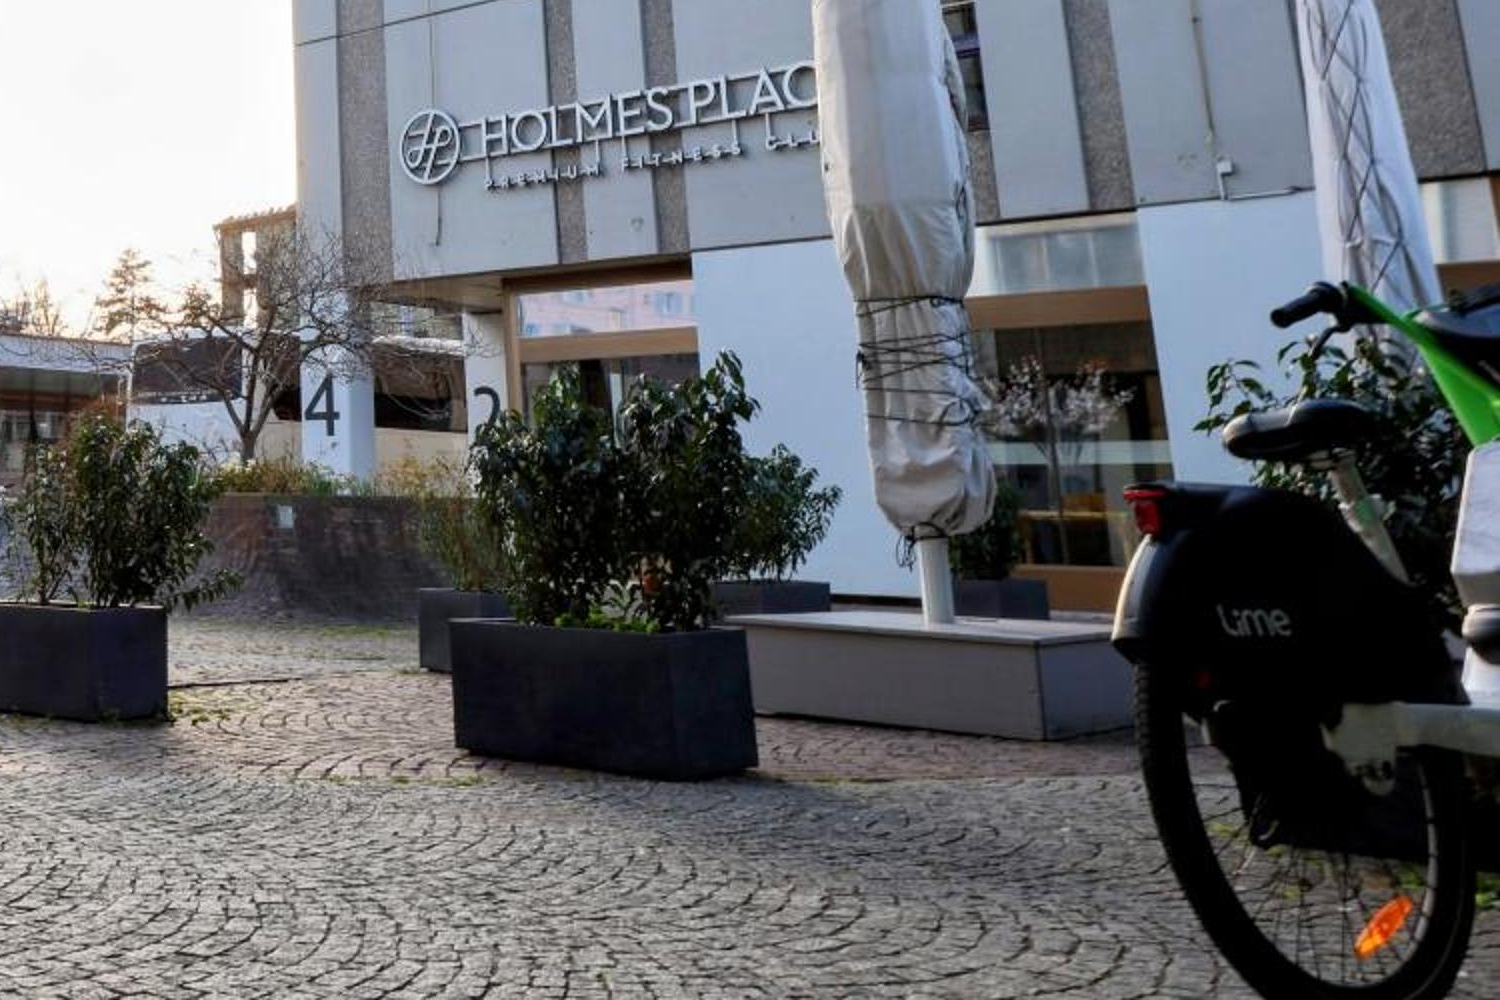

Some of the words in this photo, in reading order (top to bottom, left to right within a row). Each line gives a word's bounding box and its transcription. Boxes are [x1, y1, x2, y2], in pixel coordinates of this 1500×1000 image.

[480, 86, 675, 157] HOLMES
[686, 60, 819, 125] PLAC
[484, 164, 601, 190] PREMIUM
[620, 142, 742, 172] FITNESS
[764, 128, 821, 151] CLU
[304, 371, 340, 437] 4
[1216, 603, 1293, 637] Lime
